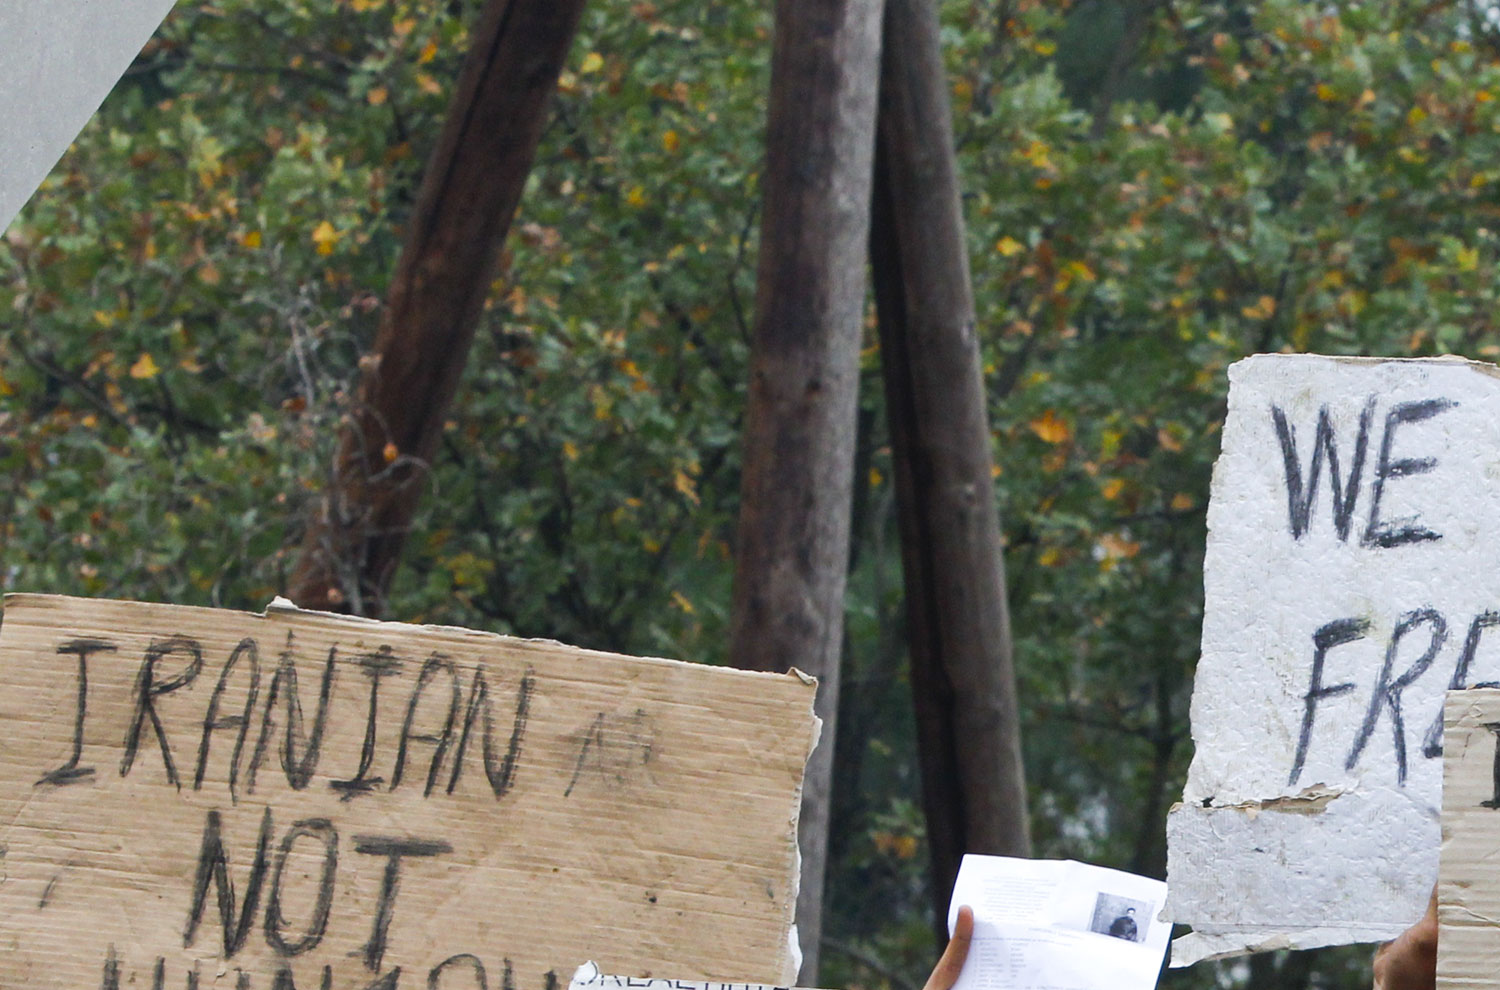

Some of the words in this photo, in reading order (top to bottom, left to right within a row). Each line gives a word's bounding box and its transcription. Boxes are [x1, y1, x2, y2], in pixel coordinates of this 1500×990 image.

[1271, 393, 1459, 549] WE
[34, 629, 535, 800] IRANIAN
[183, 806, 454, 972] NOT
